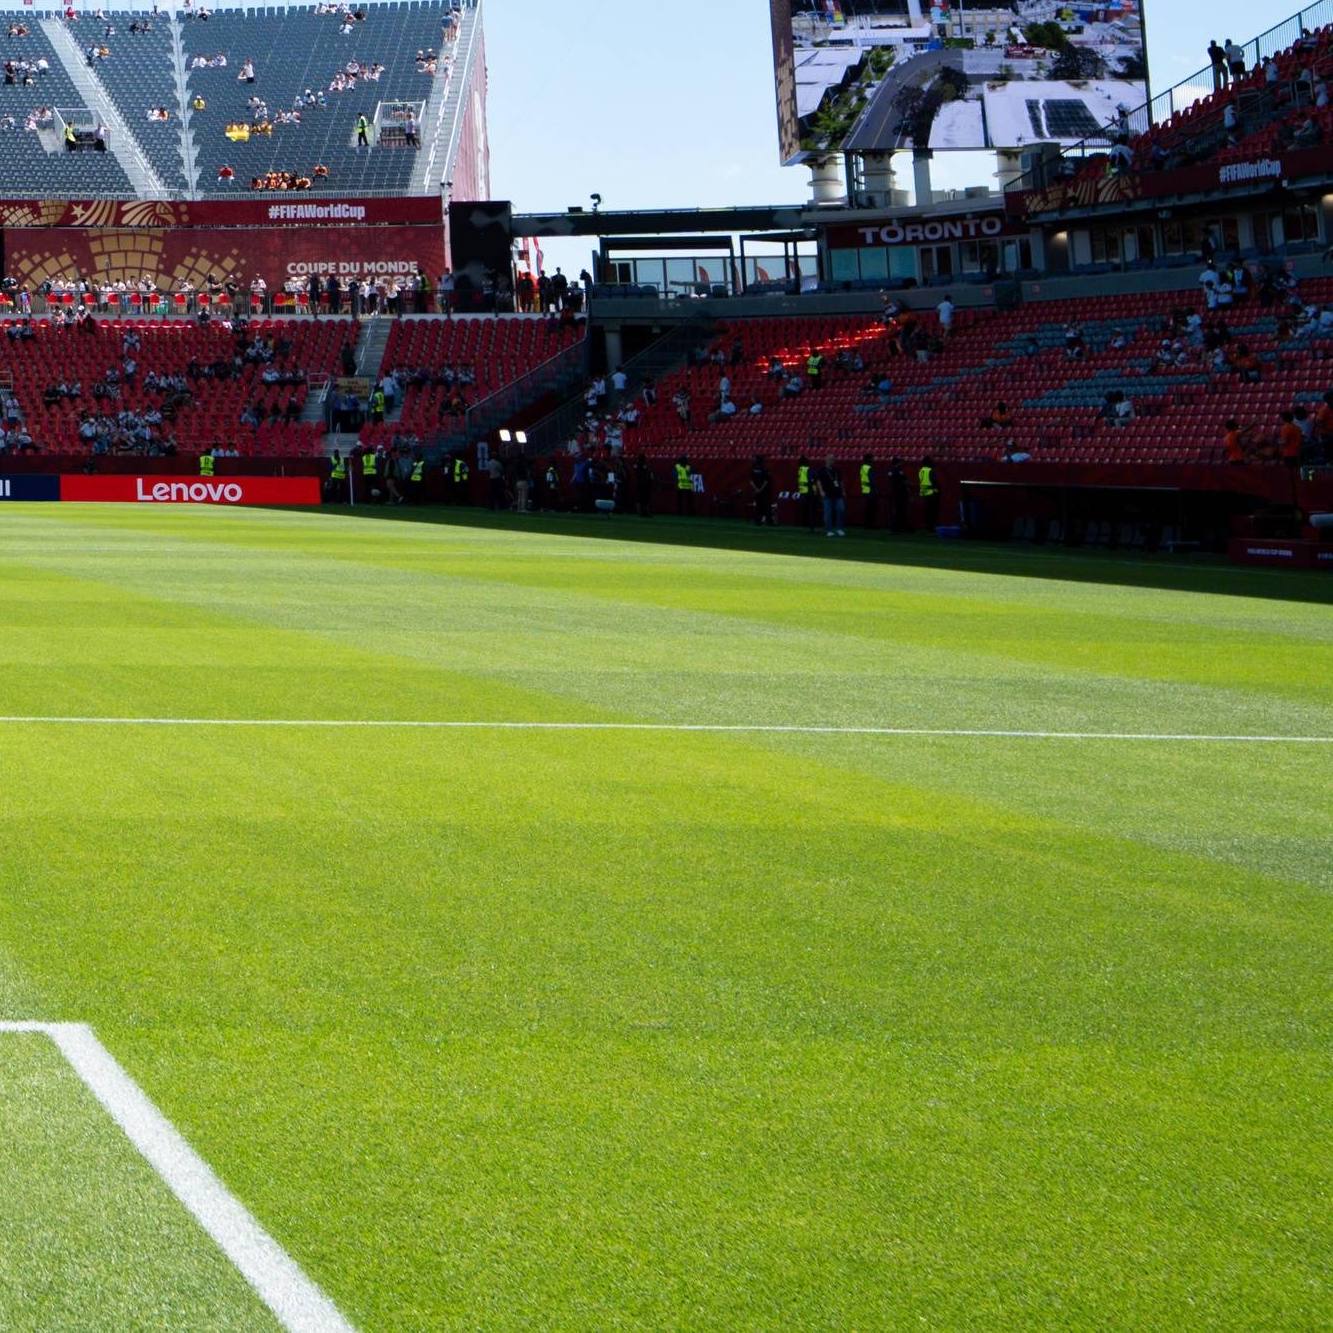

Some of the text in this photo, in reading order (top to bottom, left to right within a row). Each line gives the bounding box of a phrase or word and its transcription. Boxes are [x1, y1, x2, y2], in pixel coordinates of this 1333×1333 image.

[269, 204, 365, 219] #FIFAWorldCup
[858, 218, 1002, 243] TORONTO
[287, 261, 418, 274] COUPE DU MONDE
[137, 478, 242, 501] Lenovo
